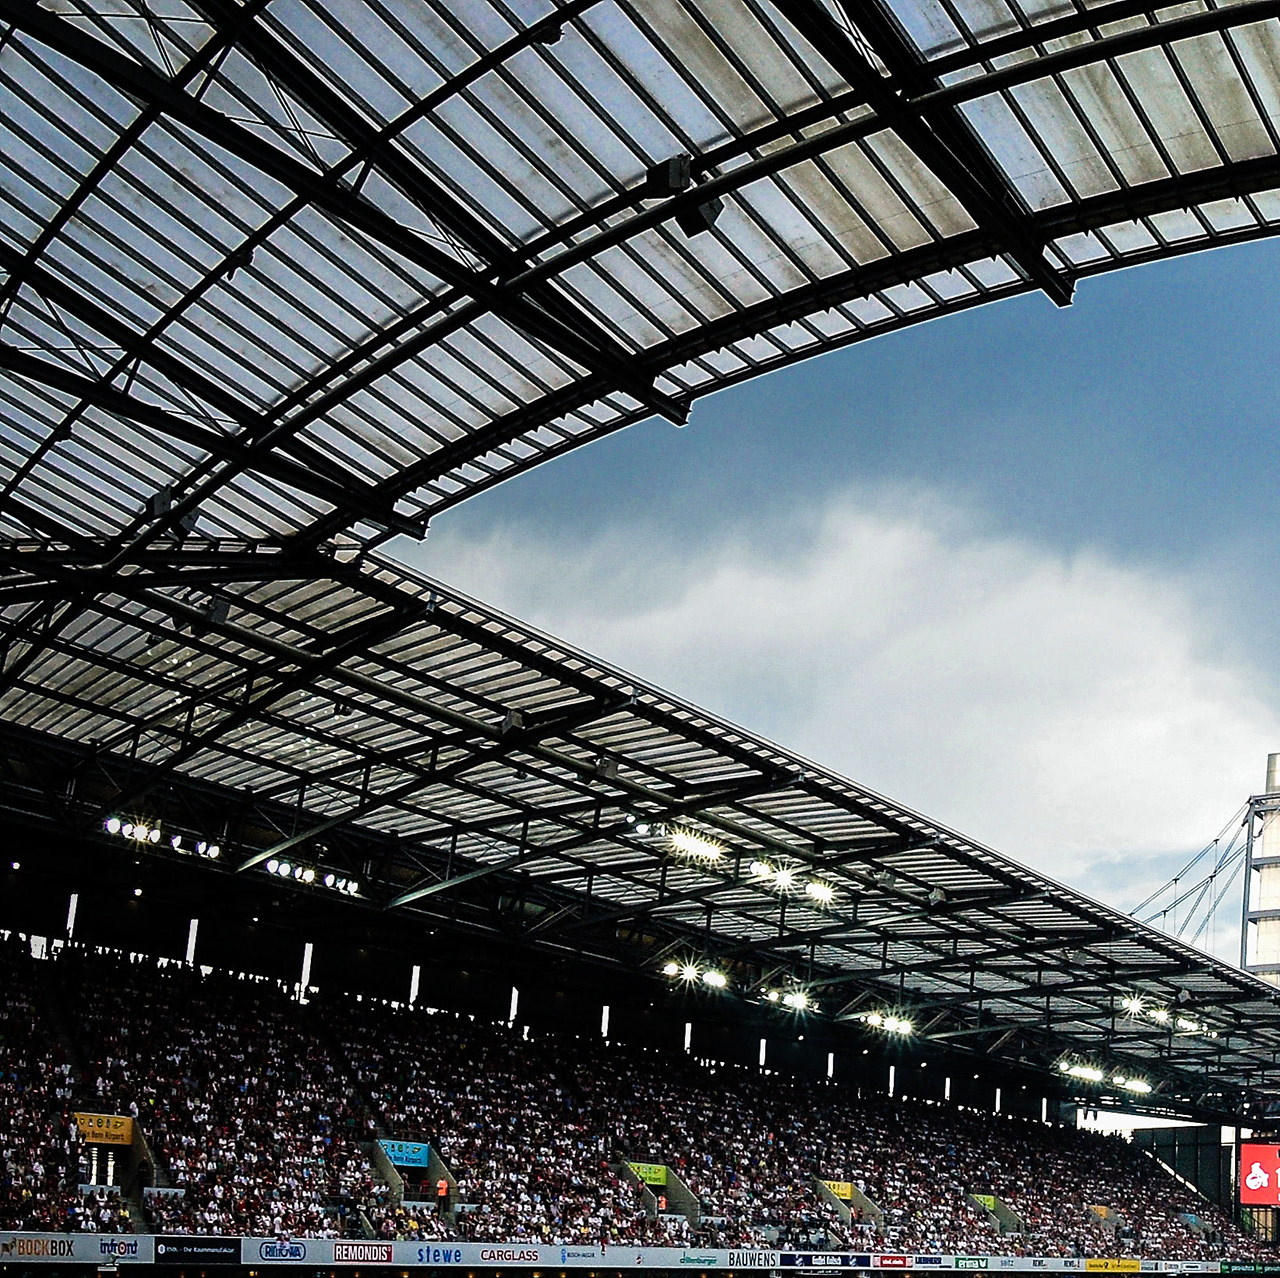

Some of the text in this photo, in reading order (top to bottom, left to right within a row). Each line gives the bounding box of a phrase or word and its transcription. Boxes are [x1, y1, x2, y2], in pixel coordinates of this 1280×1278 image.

[18, 1239, 75, 1256] BOCKBOX
[336, 1244, 389, 1261] REMONDIS
[417, 1245, 463, 1263] stewe
[481, 1249, 539, 1261] CARGLASS
[729, 1252, 776, 1267] BAUWENS
